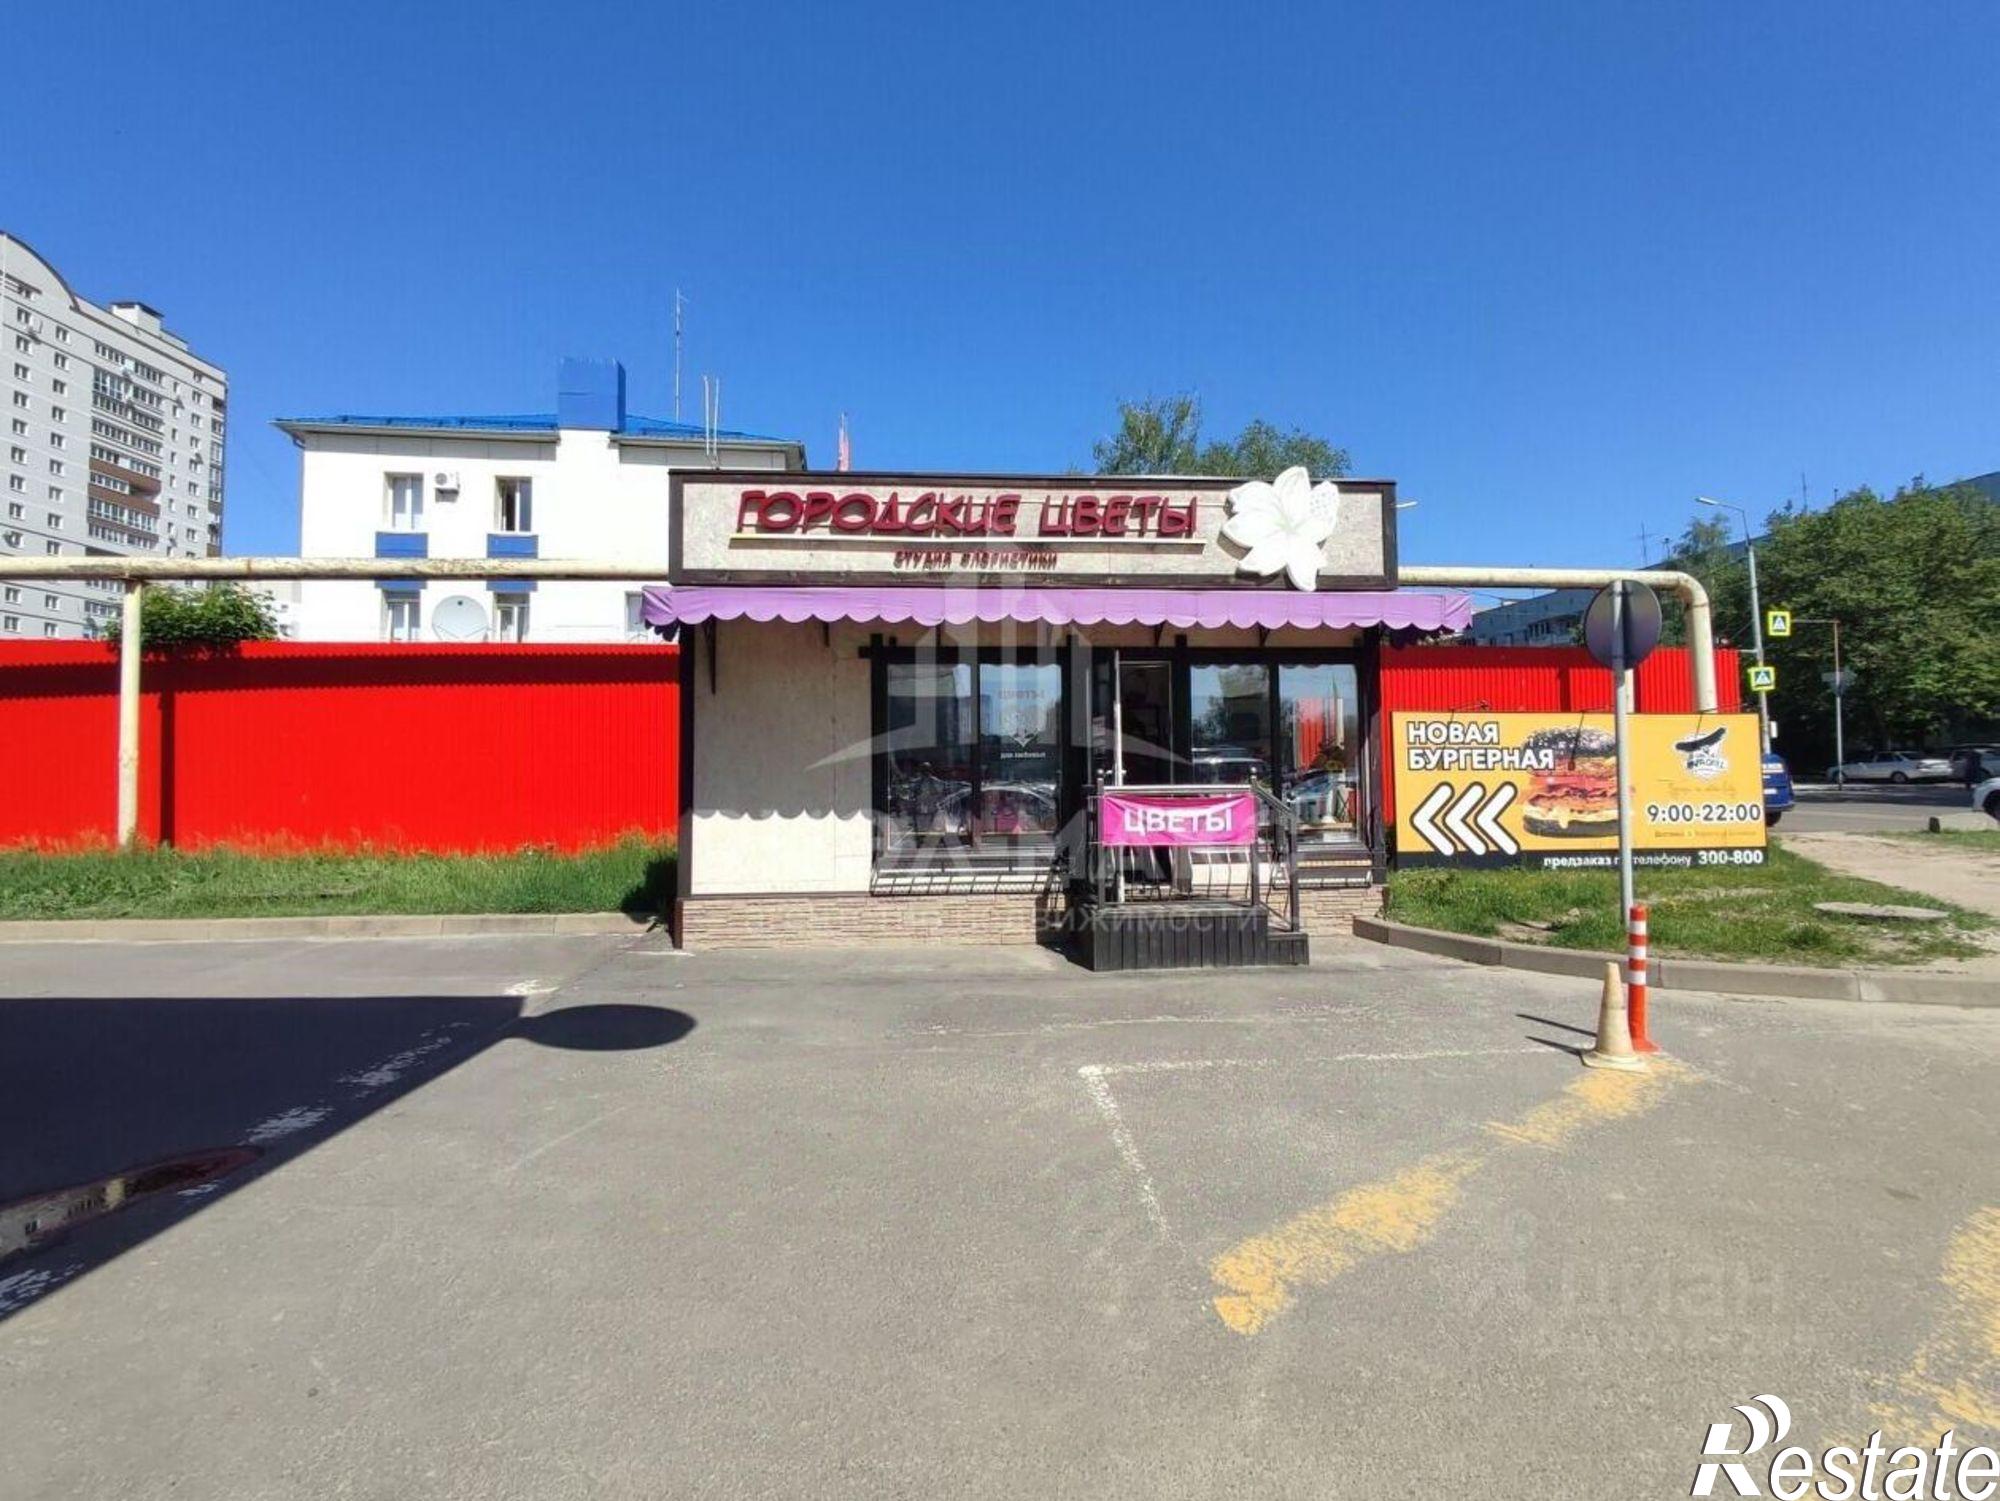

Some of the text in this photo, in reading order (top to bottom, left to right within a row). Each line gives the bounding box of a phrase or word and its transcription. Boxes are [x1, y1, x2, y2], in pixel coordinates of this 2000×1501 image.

[737, 490, 1197, 537] ГОРОДСКИЕ ЦВЕТЫ
[1406, 720, 1500, 745] НОВАЯ
[1407, 747, 1556, 771] БУРГЕРНАЯ
[1124, 807, 1232, 836] ЦВЕТЫ
[1647, 803, 1761, 822] 9:00-22:00
[1543, 856, 1612, 869] предзаказ
[1698, 850, 1763, 865] 300-800
